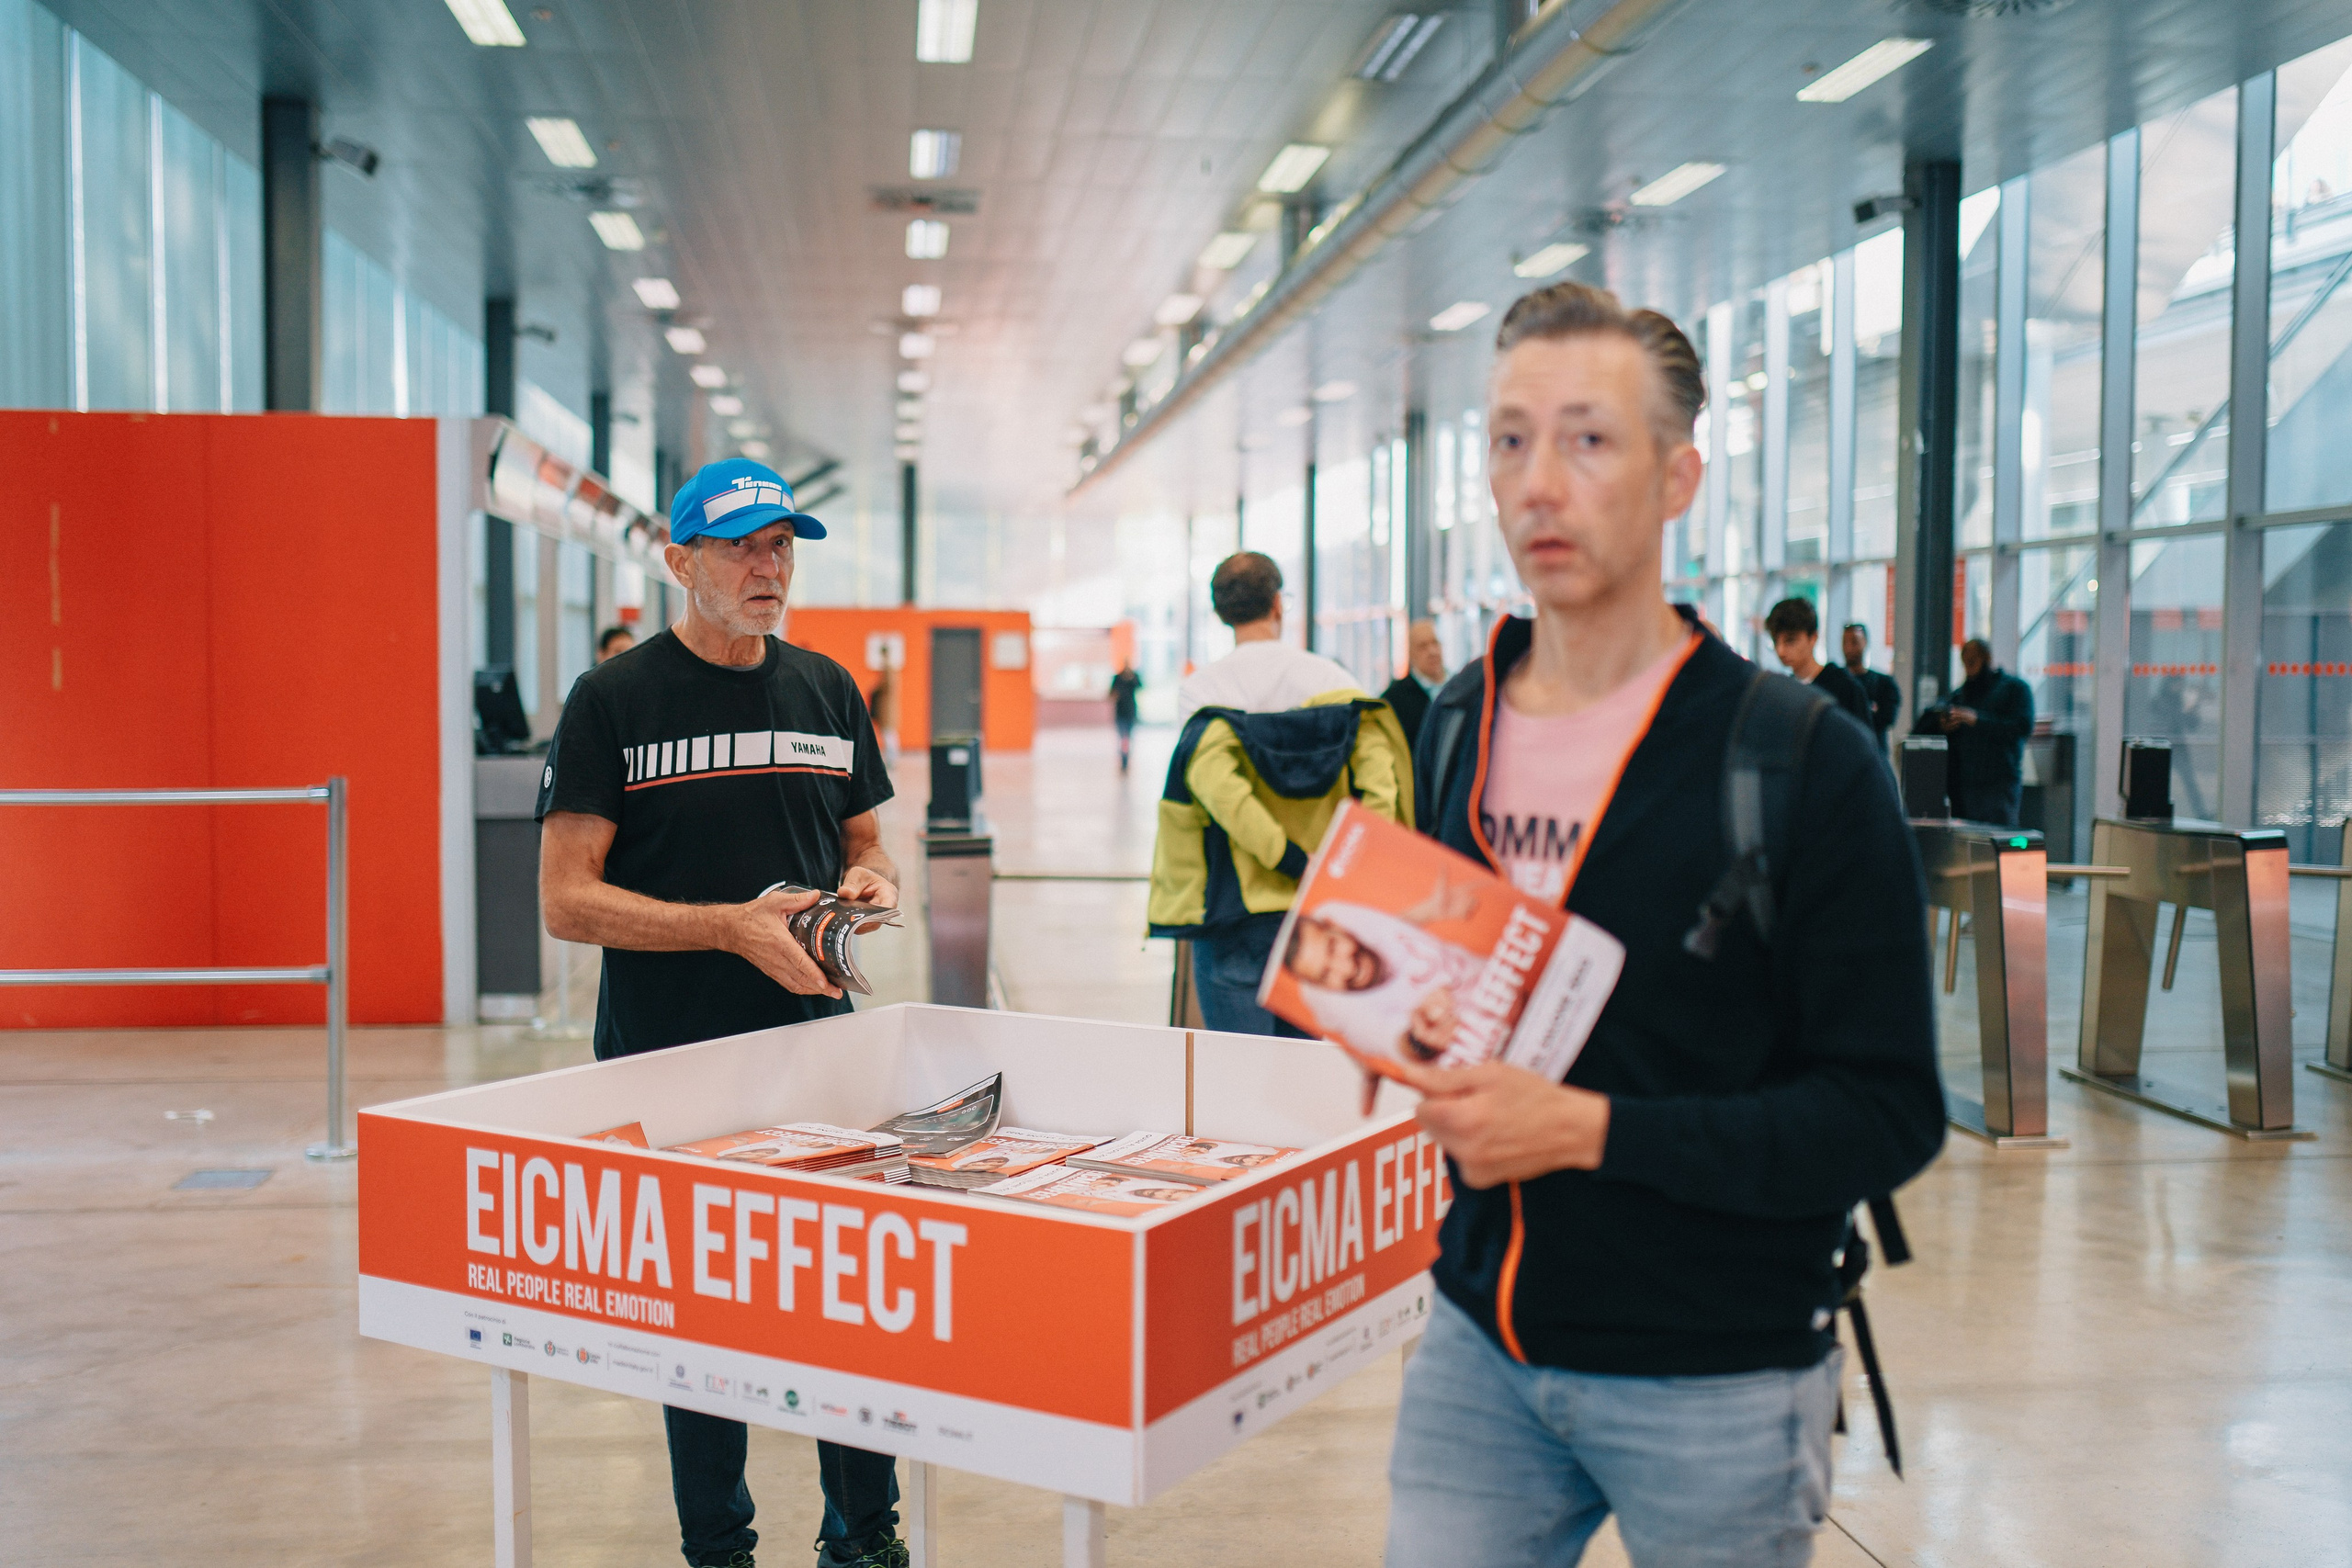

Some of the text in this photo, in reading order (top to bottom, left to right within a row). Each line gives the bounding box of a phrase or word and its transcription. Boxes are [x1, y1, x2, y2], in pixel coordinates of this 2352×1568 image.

[791, 741, 826, 757] YAMAHA
[1473, 902, 1551, 1017] EFFECT
[466, 1147, 968, 1343] EICMA EFFECT
[1232, 1130, 1453, 1326] EICMA EFFE
[468, 1263, 675, 1329] REAL PEOPLE REAL EMOTION
[1232, 1331, 1260, 1368] REAL
[1261, 1307, 1299, 1352] PEOPLE
[1299, 1295, 1324, 1333] REAL
[1325, 1272, 1365, 1318] EMOTION
